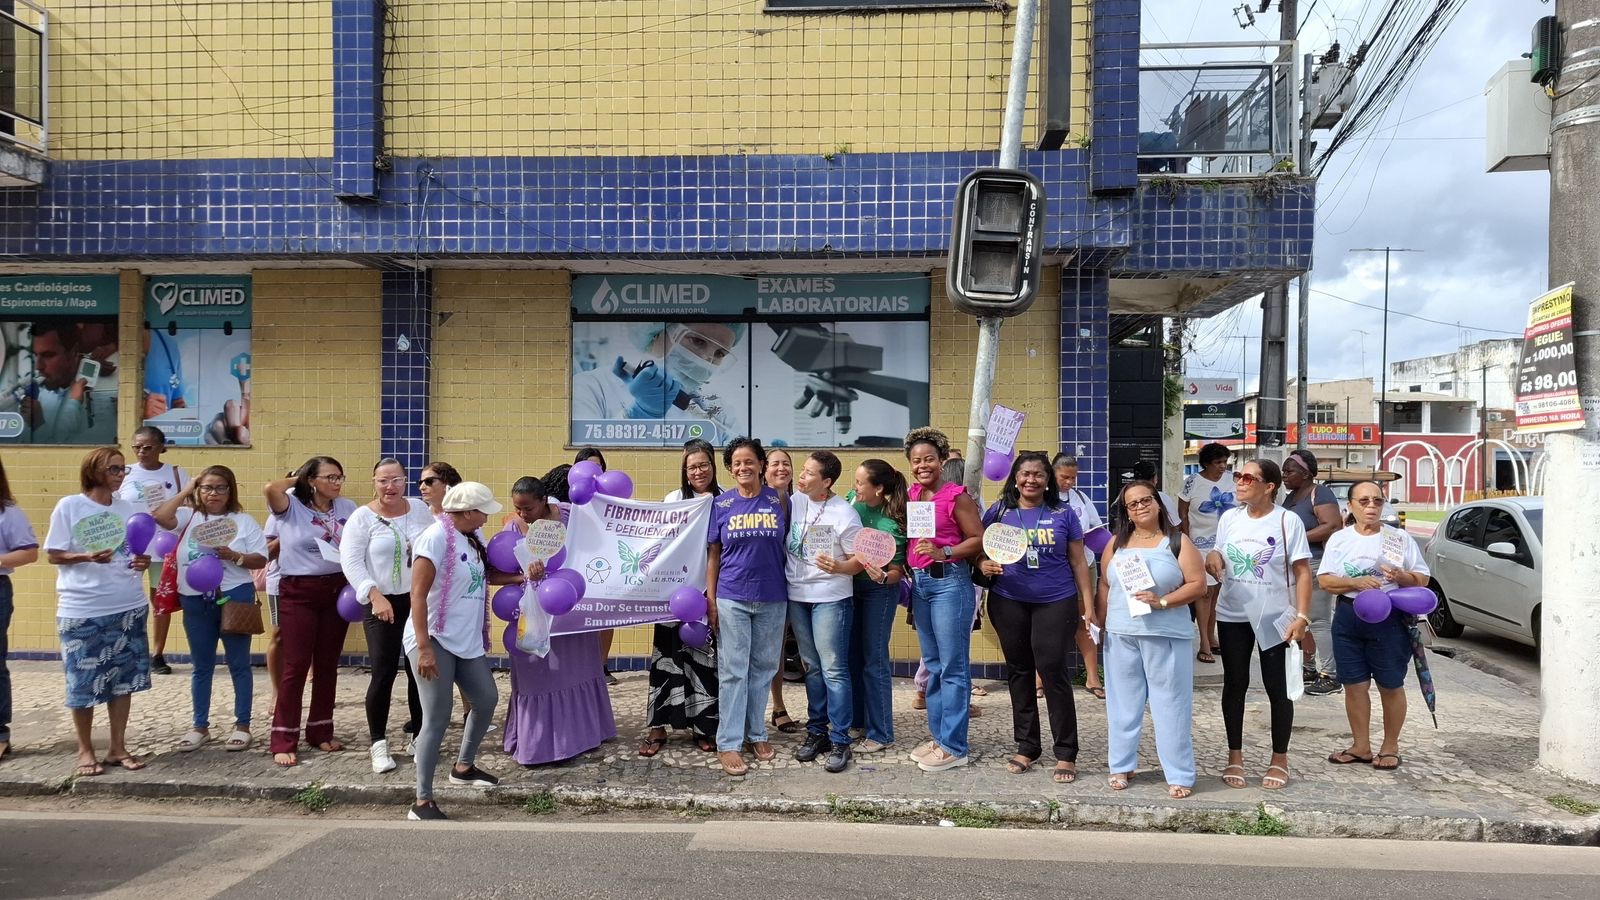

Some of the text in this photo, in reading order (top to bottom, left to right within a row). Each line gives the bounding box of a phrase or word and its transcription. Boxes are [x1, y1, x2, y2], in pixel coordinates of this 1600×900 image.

[1023, 203, 1036, 274] CONTRANSIN
[14, 282, 92, 294] Cardiológicos
[757, 278, 836, 294] EXAMES
[179, 289, 245, 305] CLIMED
[620, 284, 711, 304] CLIMED
[1, 297, 63, 308] Espirometria
[757, 296, 909, 313] LABORATORIAIS
[1521, 370, 1577, 393] R$ 98,00
[1215, 384, 1233, 392] Vida
[1520, 415, 1548, 425] DINHEIRO
[1560, 411, 1581, 421] HORA
[585, 424, 685, 439] 75.98312-4517
[1311, 426, 1333, 434] TUDO
[604, 503, 689, 524] FIBROMIALGIA
[88, 517, 105, 527] NÃO
[542, 523, 556, 532] NÃO
[727, 513, 779, 531] SEMPRE
[83, 522, 116, 537] SEREMOS
[727, 530, 778, 539] PRESENTE
[1000, 527, 1014, 538] NÃO
[534, 531, 560, 541] SEREMOS
[870, 532, 883, 541] NÃO
[992, 534, 1019, 548] SEREMOS
[527, 538, 562, 548] SILENCIADAS
[862, 539, 889, 551] SEREMOS
[986, 540, 1022, 556] SILENCIADAS
[624, 575, 644, 586] IGS
[595, 602, 616, 612] Dor
[618, 603, 632, 612] Se
[634, 603, 671, 613] transf
[584, 617, 603, 627] Em
